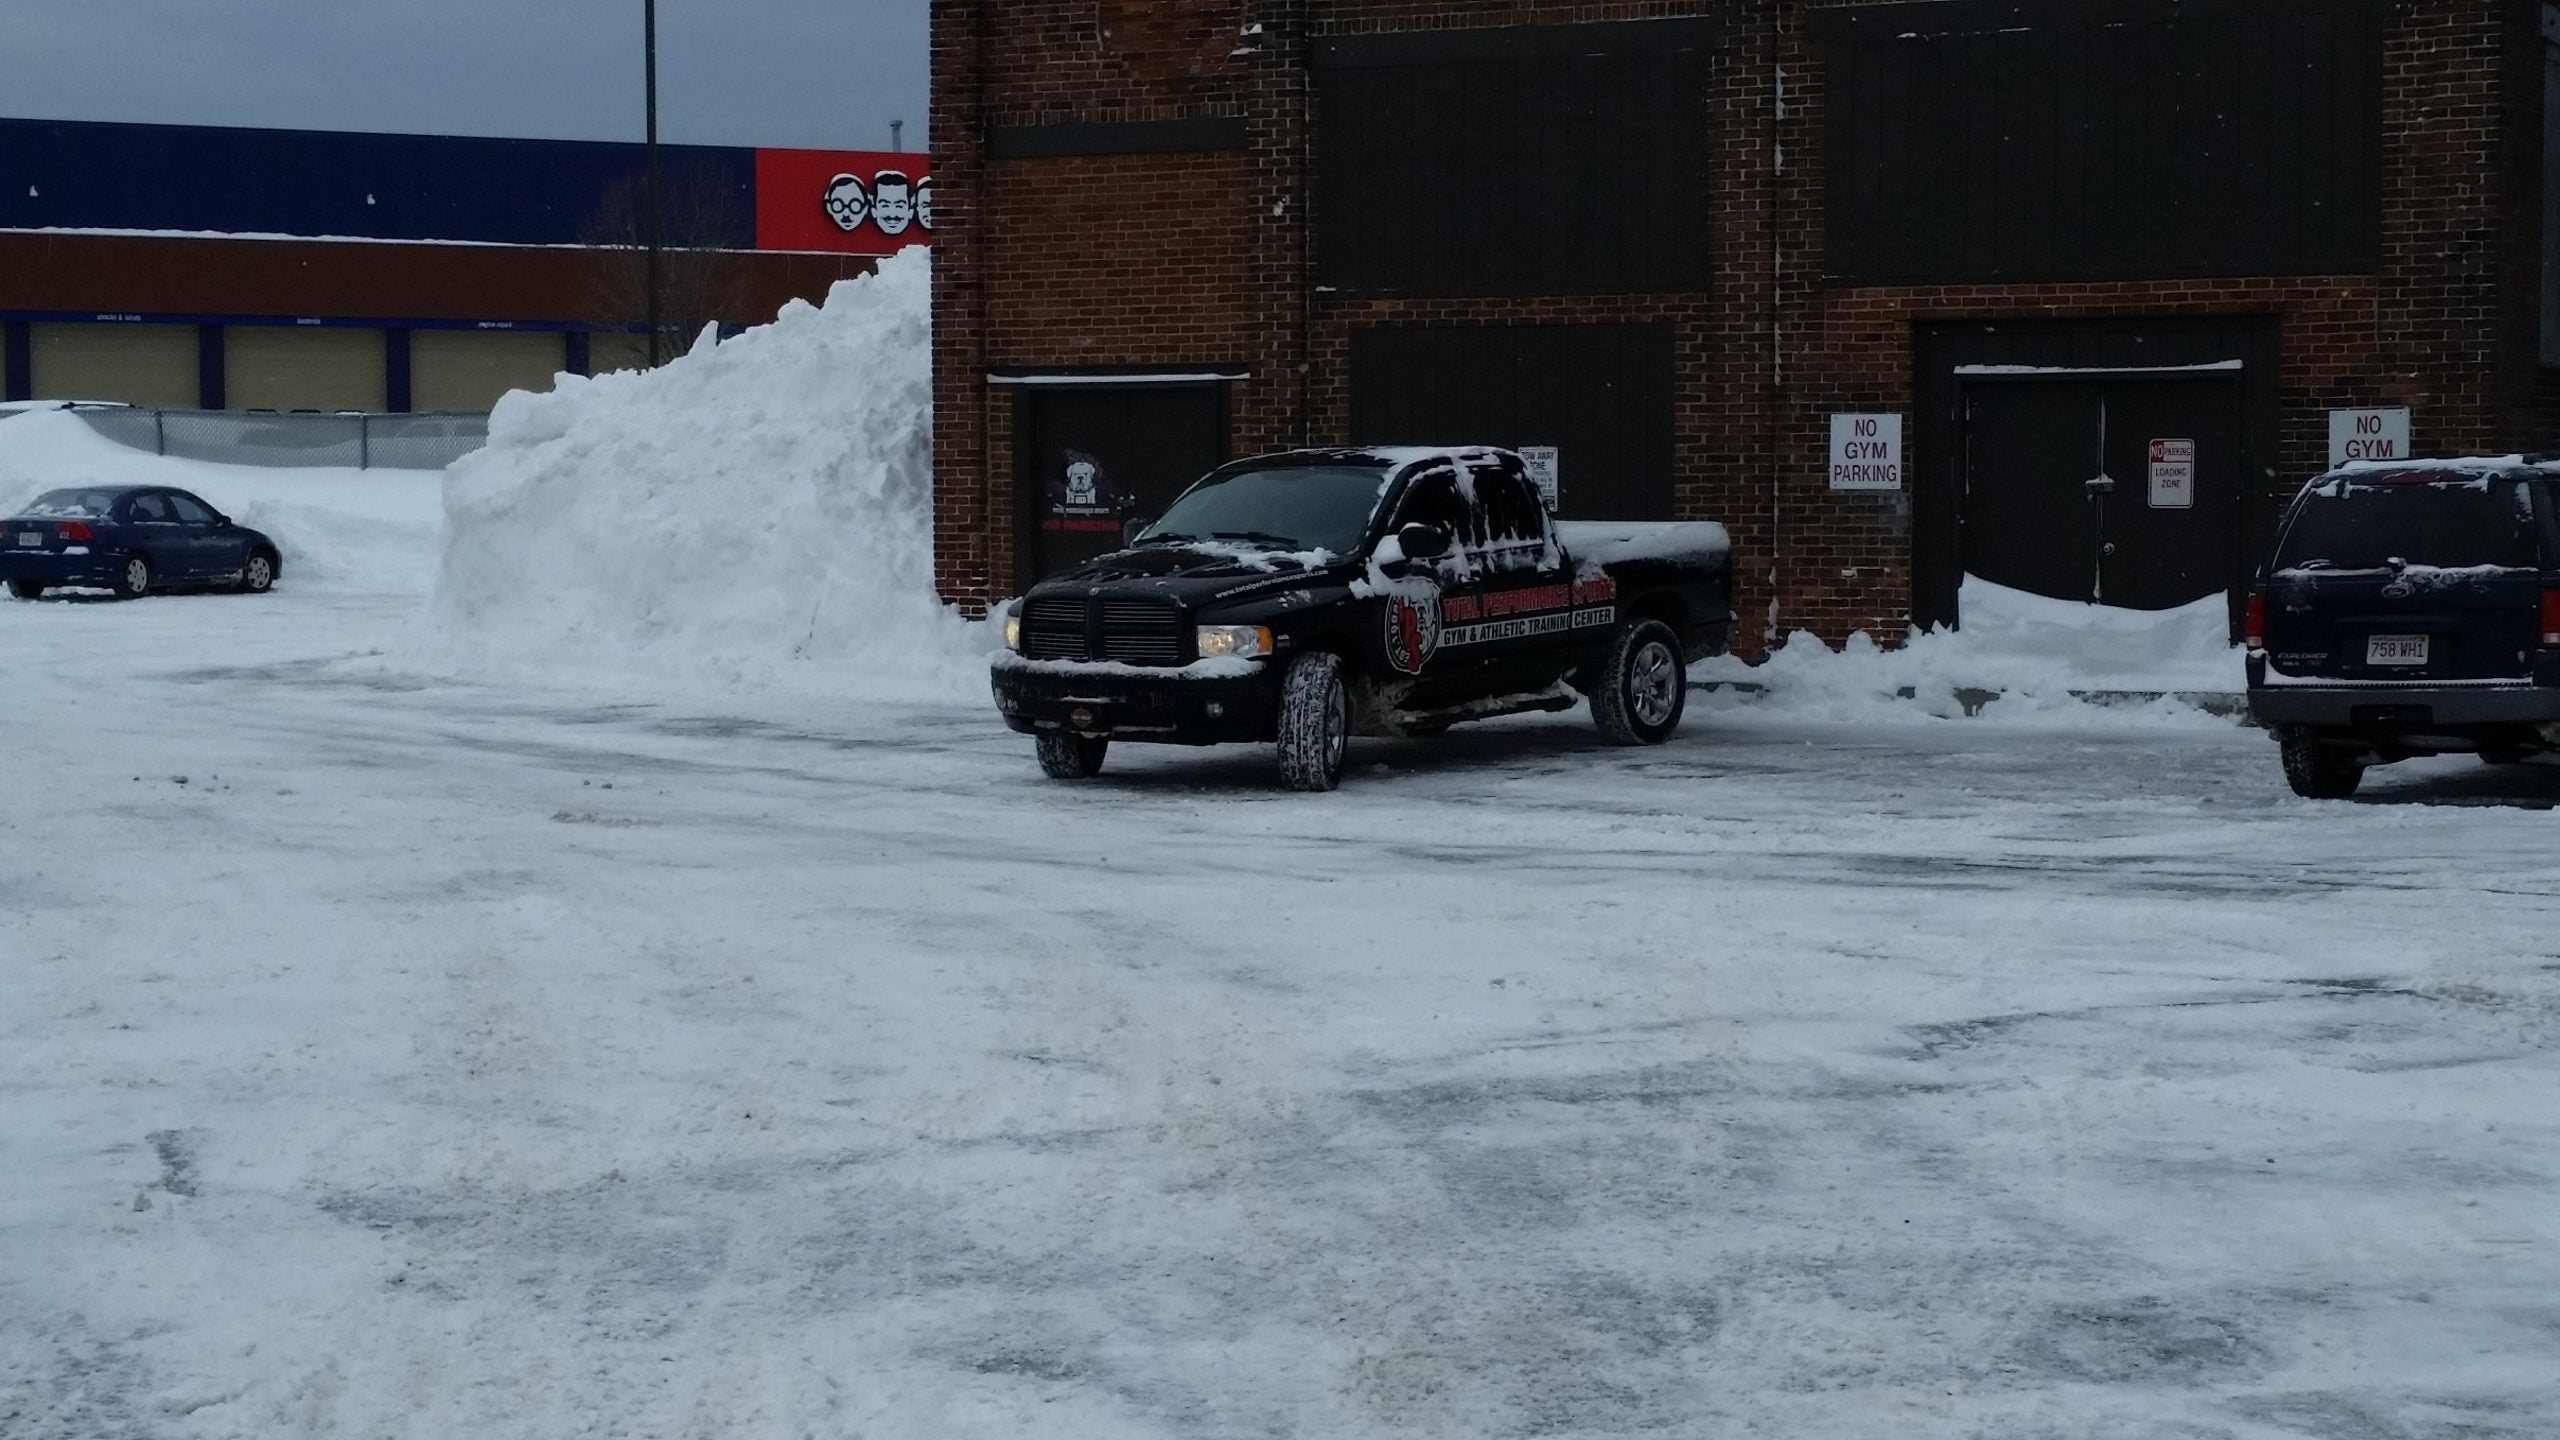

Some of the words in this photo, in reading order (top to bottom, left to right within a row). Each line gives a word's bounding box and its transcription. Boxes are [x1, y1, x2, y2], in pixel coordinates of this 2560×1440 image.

[1855, 419, 1877, 437] NO
[2357, 415, 2381, 434] NO
[1845, 441, 1887, 459] GYM
[2152, 445, 2163, 458] NO
[2345, 440, 2393, 458] GYM
[1834, 464, 1897, 482] PARKING
[2155, 467, 2187, 477] LOADING
[2161, 479, 2182, 489] ZONE
[1442, 595, 1481, 622] TOTAL
[1444, 628, 1467, 645] GYM
[1470, 626, 1478, 642] &
[1480, 620, 1525, 641] ATHLETIC
[1528, 613, 1570, 634] TRAINING
[1574, 608, 1611, 628] CENTER
[2371, 642, 2396, 657] 758
